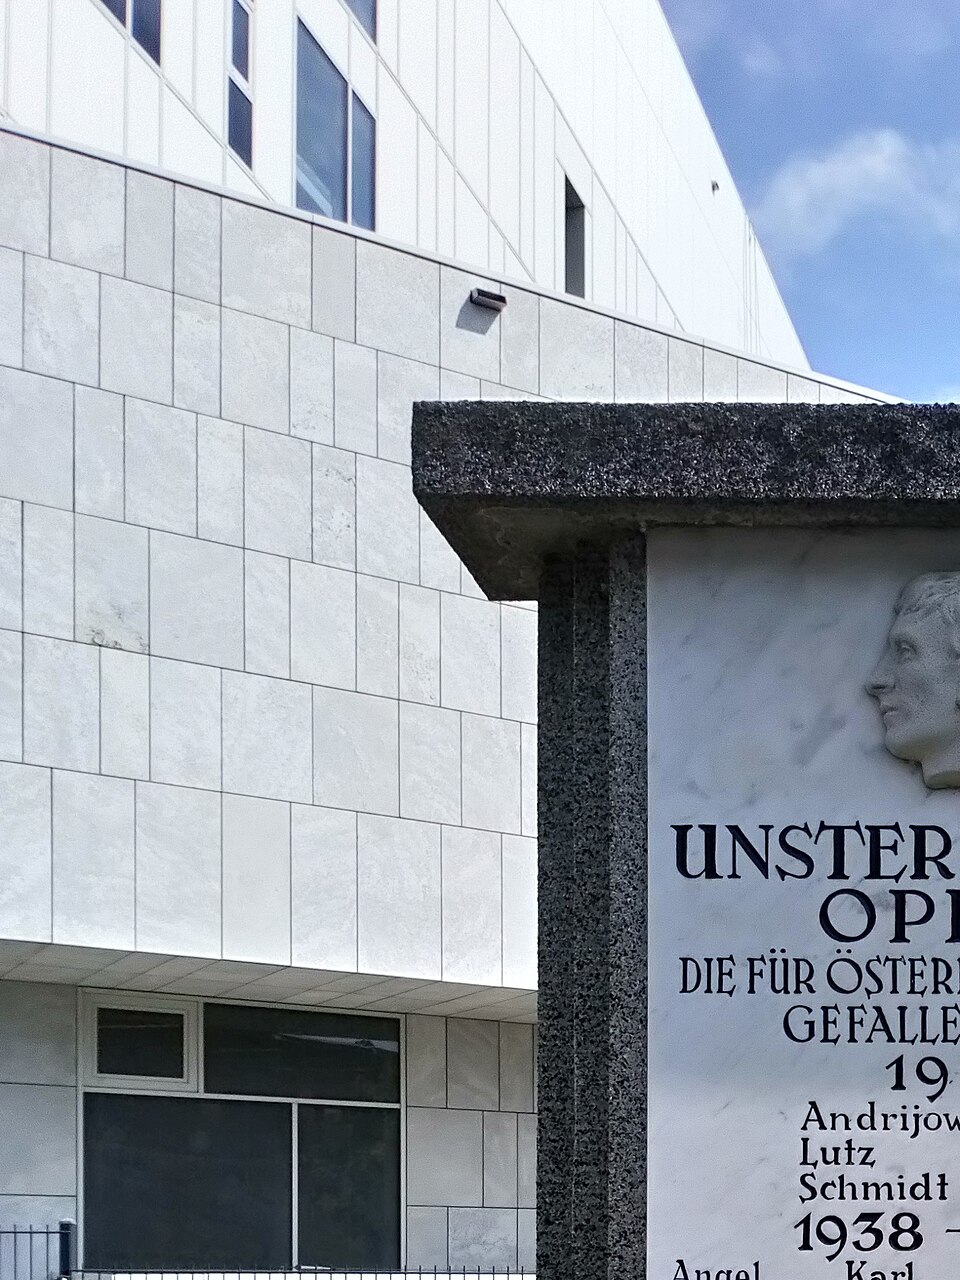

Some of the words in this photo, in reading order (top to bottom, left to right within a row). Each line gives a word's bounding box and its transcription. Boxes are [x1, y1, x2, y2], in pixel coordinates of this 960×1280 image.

[678, 953, 737, 997] DIE
[746, 949, 817, 995] FÜR
[799, 1138, 877, 1170] Lutz
[798, 1172, 949, 1205] Schmidt
[793, 1211, 924, 1263] 1938
